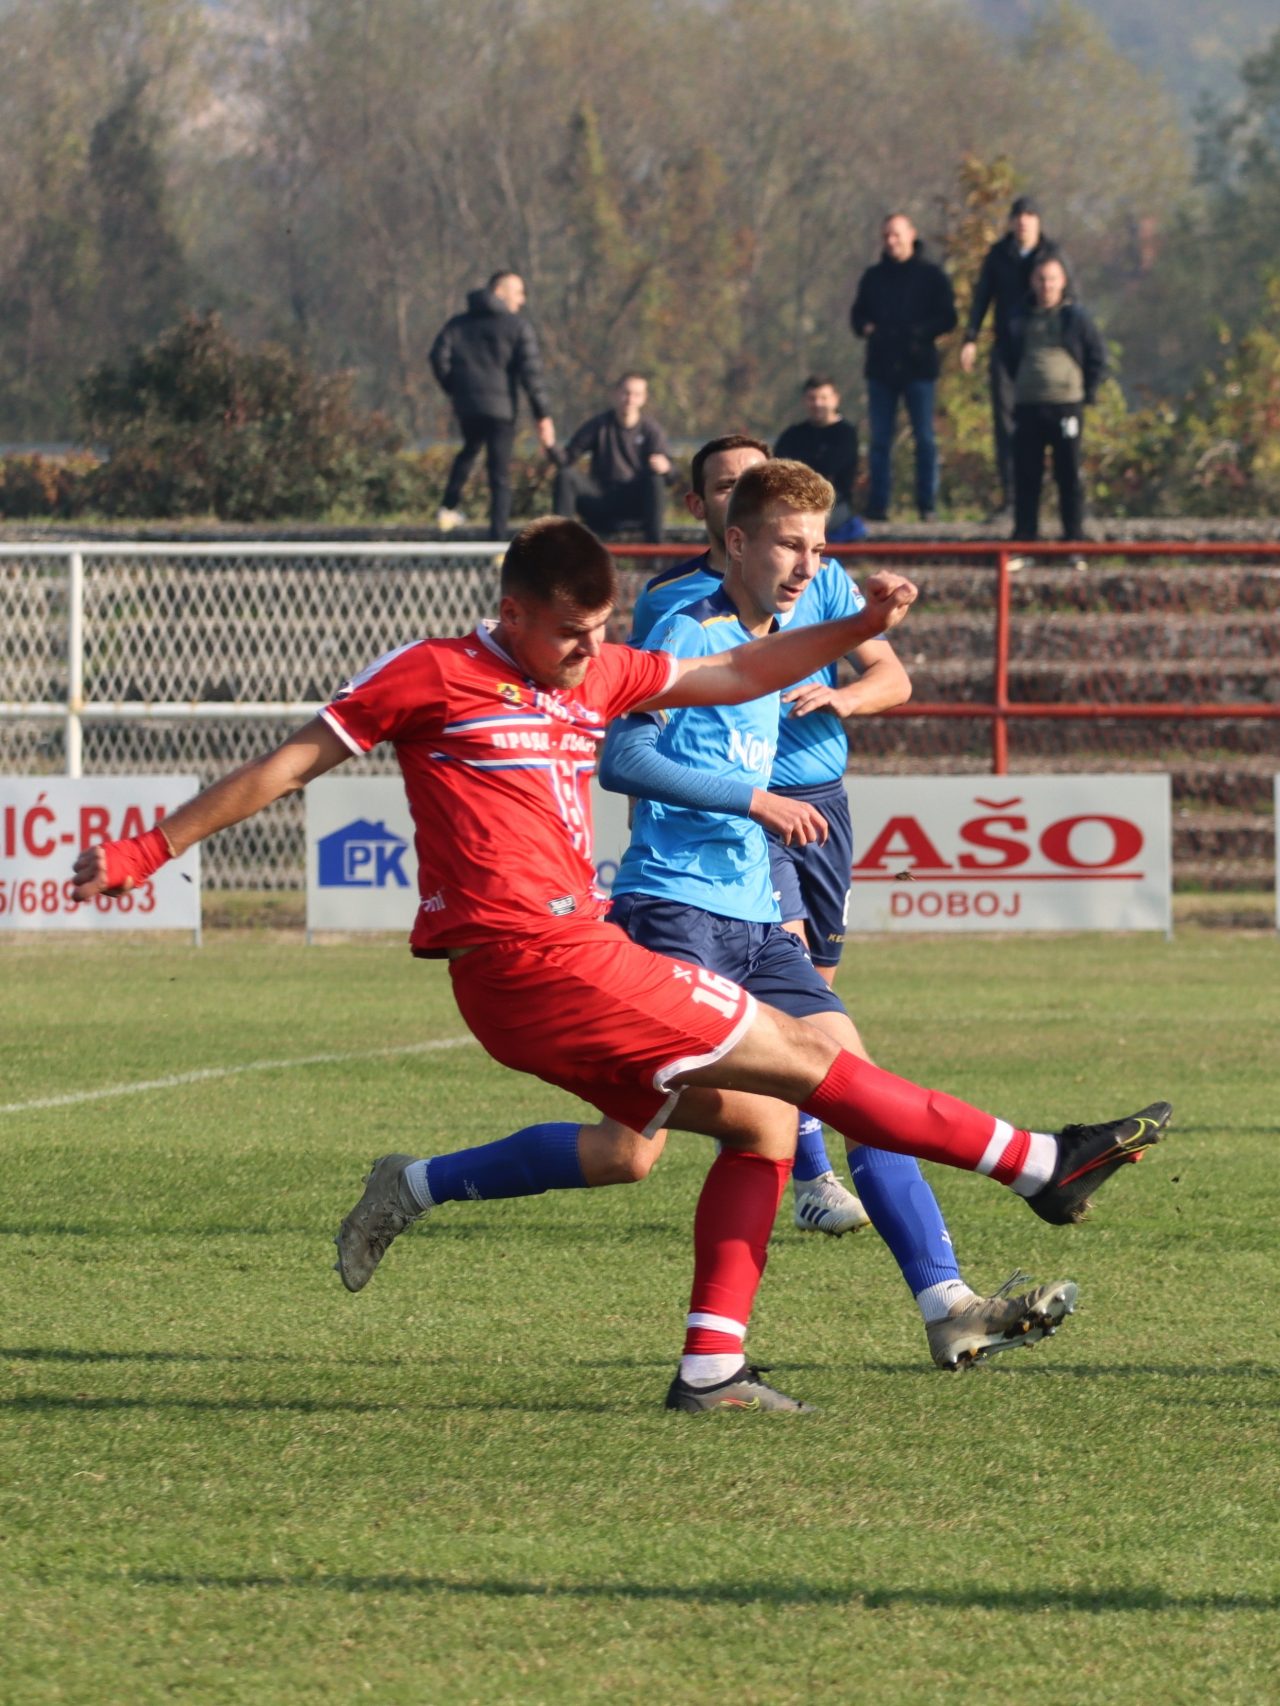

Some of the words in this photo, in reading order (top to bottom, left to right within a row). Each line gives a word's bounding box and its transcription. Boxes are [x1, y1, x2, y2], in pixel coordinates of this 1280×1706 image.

[5, 792, 167, 858] IĆ-BA
[851, 796, 1145, 870] AŠO
[347, 845, 411, 888] PK
[890, 890, 1021, 918] DOBOJ
[691, 966, 741, 1020] 16
